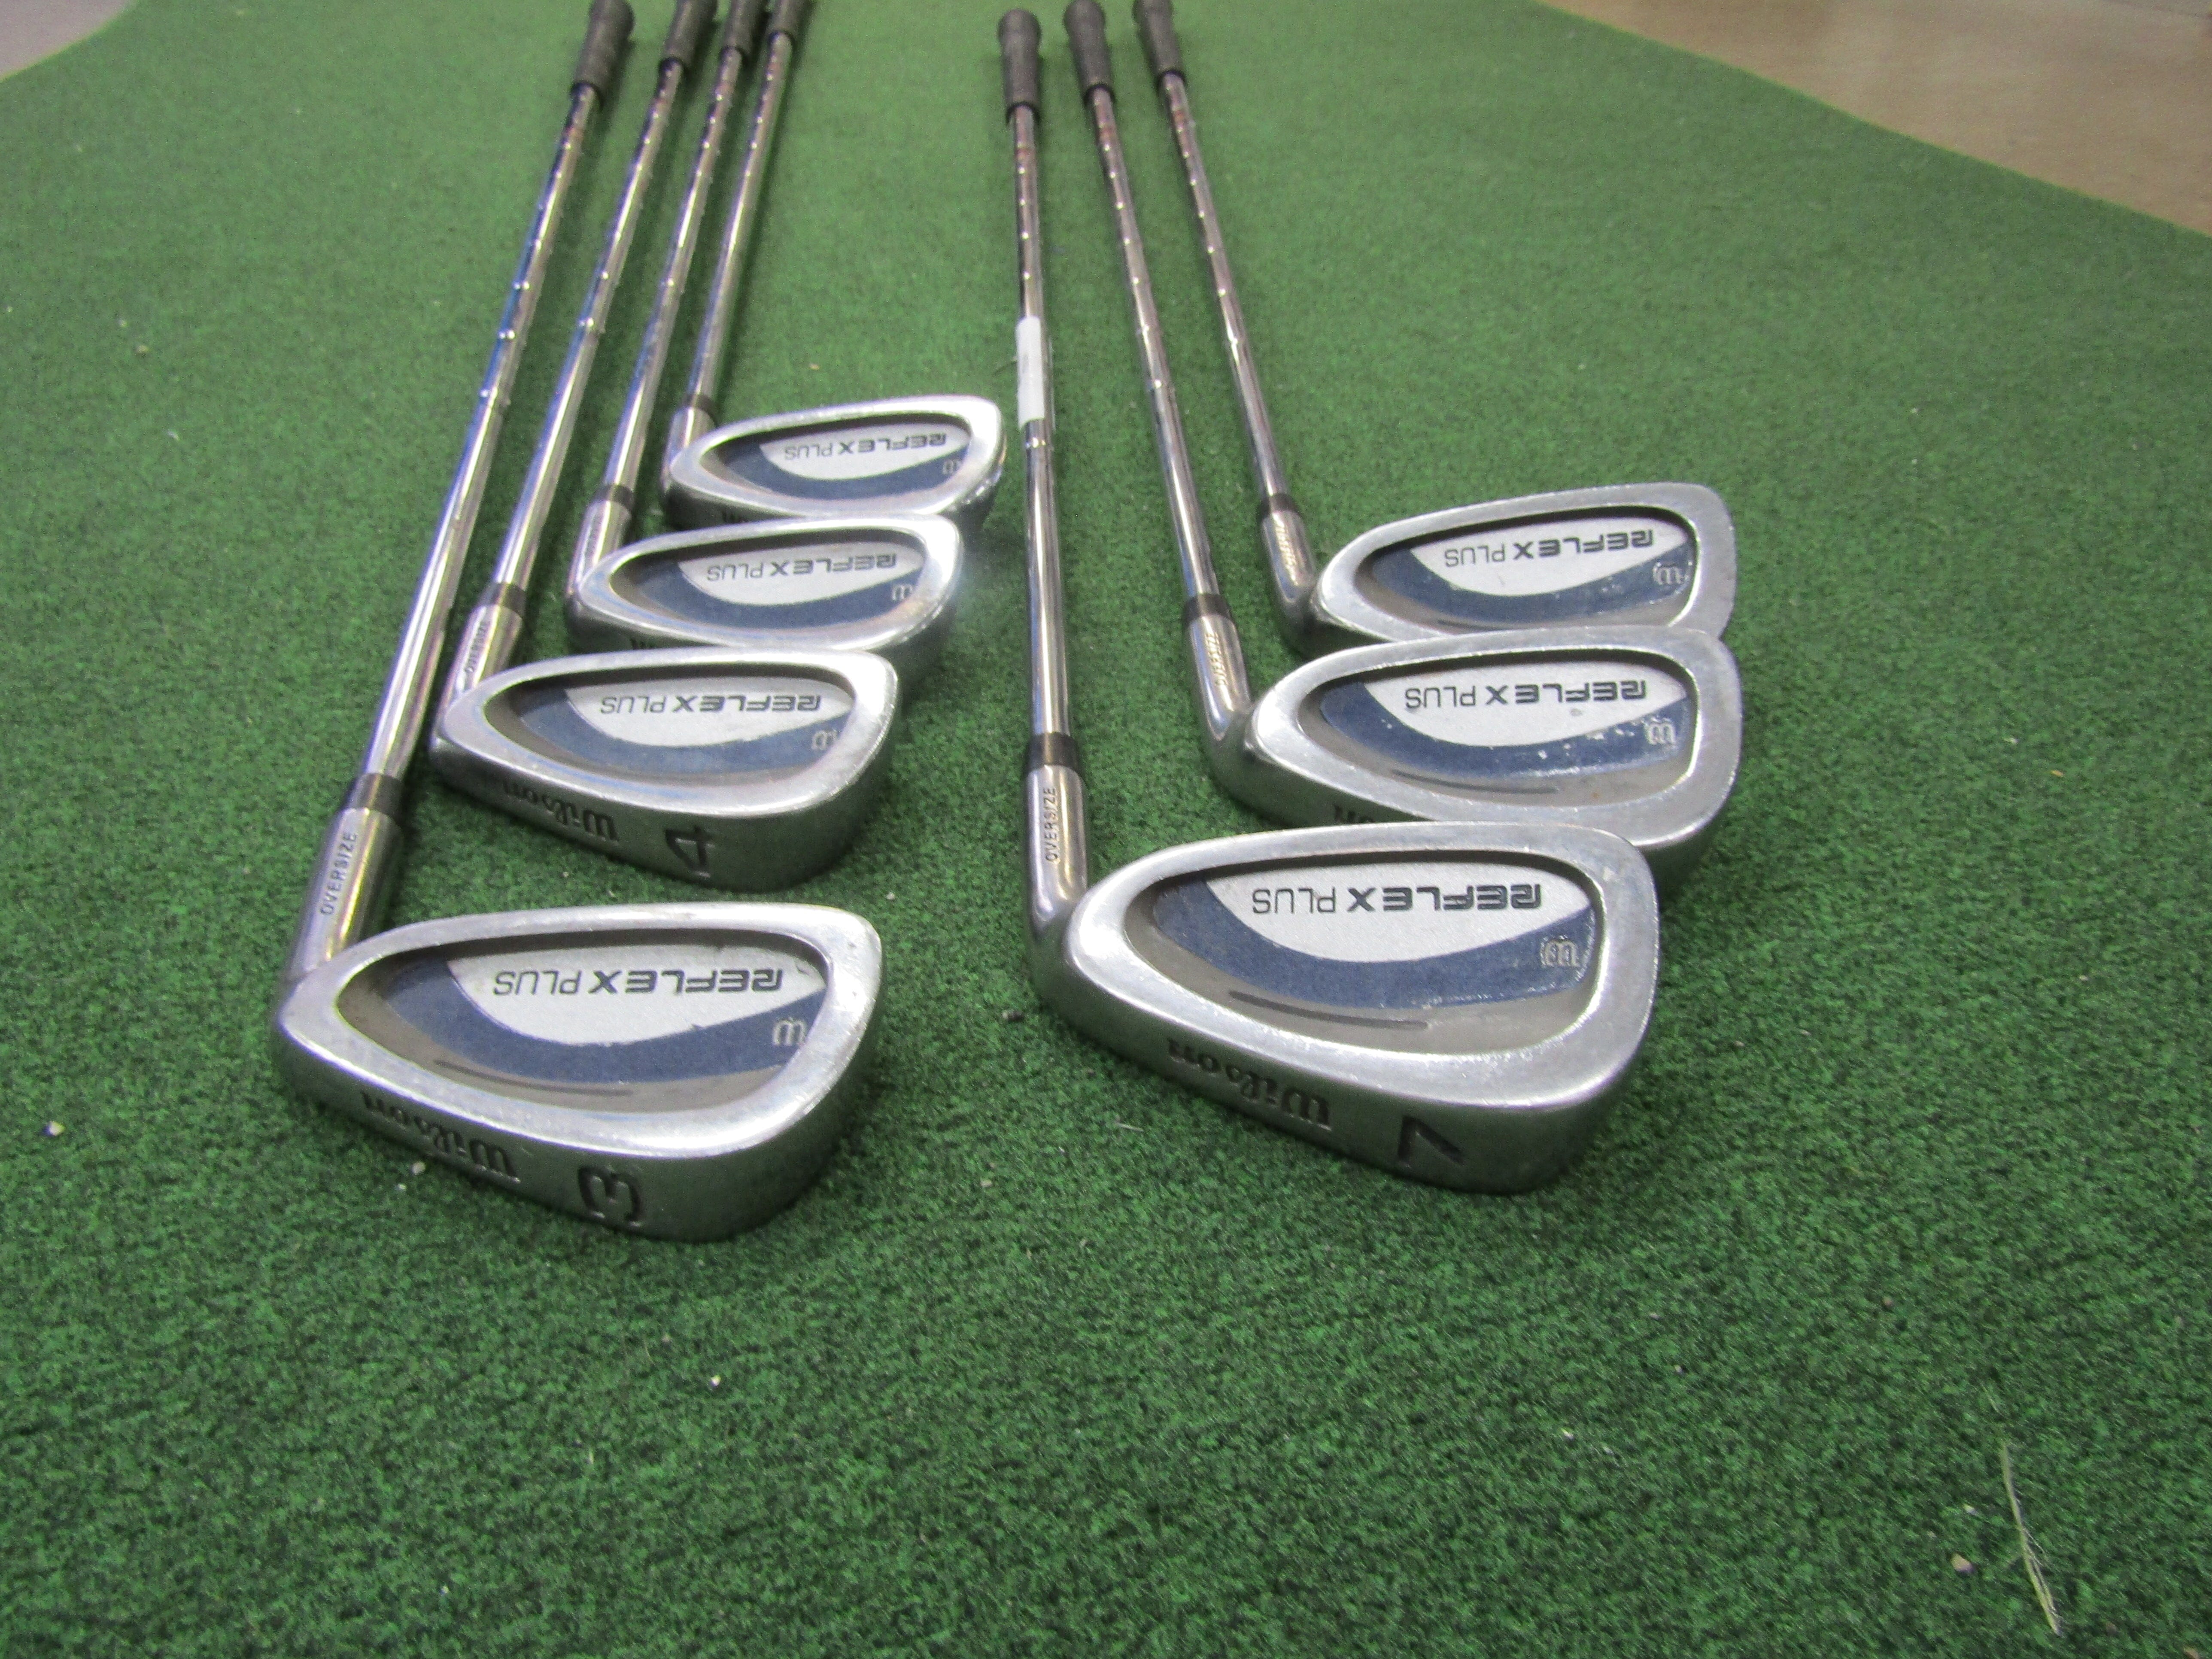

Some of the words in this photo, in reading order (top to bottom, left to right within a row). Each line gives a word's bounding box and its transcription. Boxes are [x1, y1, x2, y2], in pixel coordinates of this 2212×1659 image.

[784, 442, 833, 460] PLUS
[838, 432, 947, 455] REFLEX
[1444, 542, 1506, 567] PLUS
[1513, 529, 1654, 559] REFLEX
[706, 562, 763, 581] PLUS
[770, 553, 897, 576] REFLEX
[601, 695, 667, 714] PLUS
[672, 695, 822, 713] REFLEX
[1404, 685, 1476, 709] PLUS
[1485, 680, 1647, 705] REFLEX
[504, 780, 621, 846] Wilson
[1043, 787, 1060, 864] OVERSIZE
[664, 825, 715, 878] 4
[319, 831, 357, 915] OVERSIZE
[1252, 887, 1337, 914] PLUS
[1347, 884, 1542, 912] REFLEX
[493, 970, 582, 995] PLUS
[590, 969, 784, 995] REFLEX
[1168, 1037, 1332, 1131] Wilson
[362, 1091, 521, 1184] Wilson
[1397, 1115, 1465, 1169] 7
[578, 1165, 641, 1227] 3
